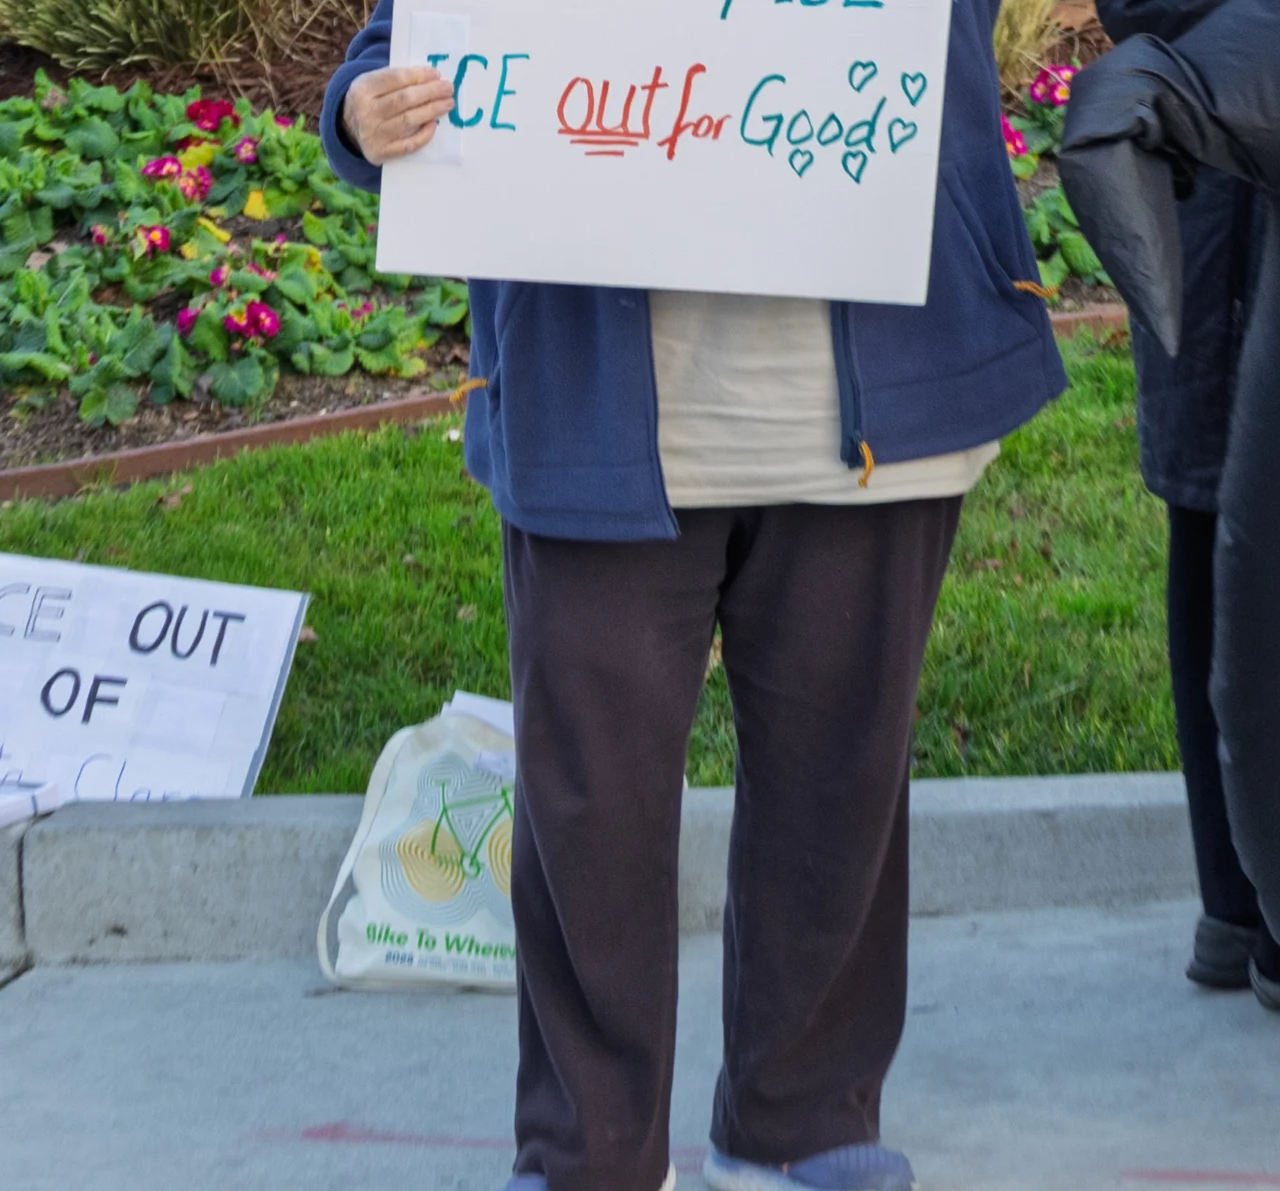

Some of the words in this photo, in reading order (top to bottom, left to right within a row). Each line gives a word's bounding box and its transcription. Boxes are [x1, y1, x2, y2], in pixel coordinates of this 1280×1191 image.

[657, 63, 732, 160] for
[740, 74, 888, 157] Good
[129, 599, 246, 666] OUT
[40, 665, 128, 724] OF
[416, 927, 437, 950] To
